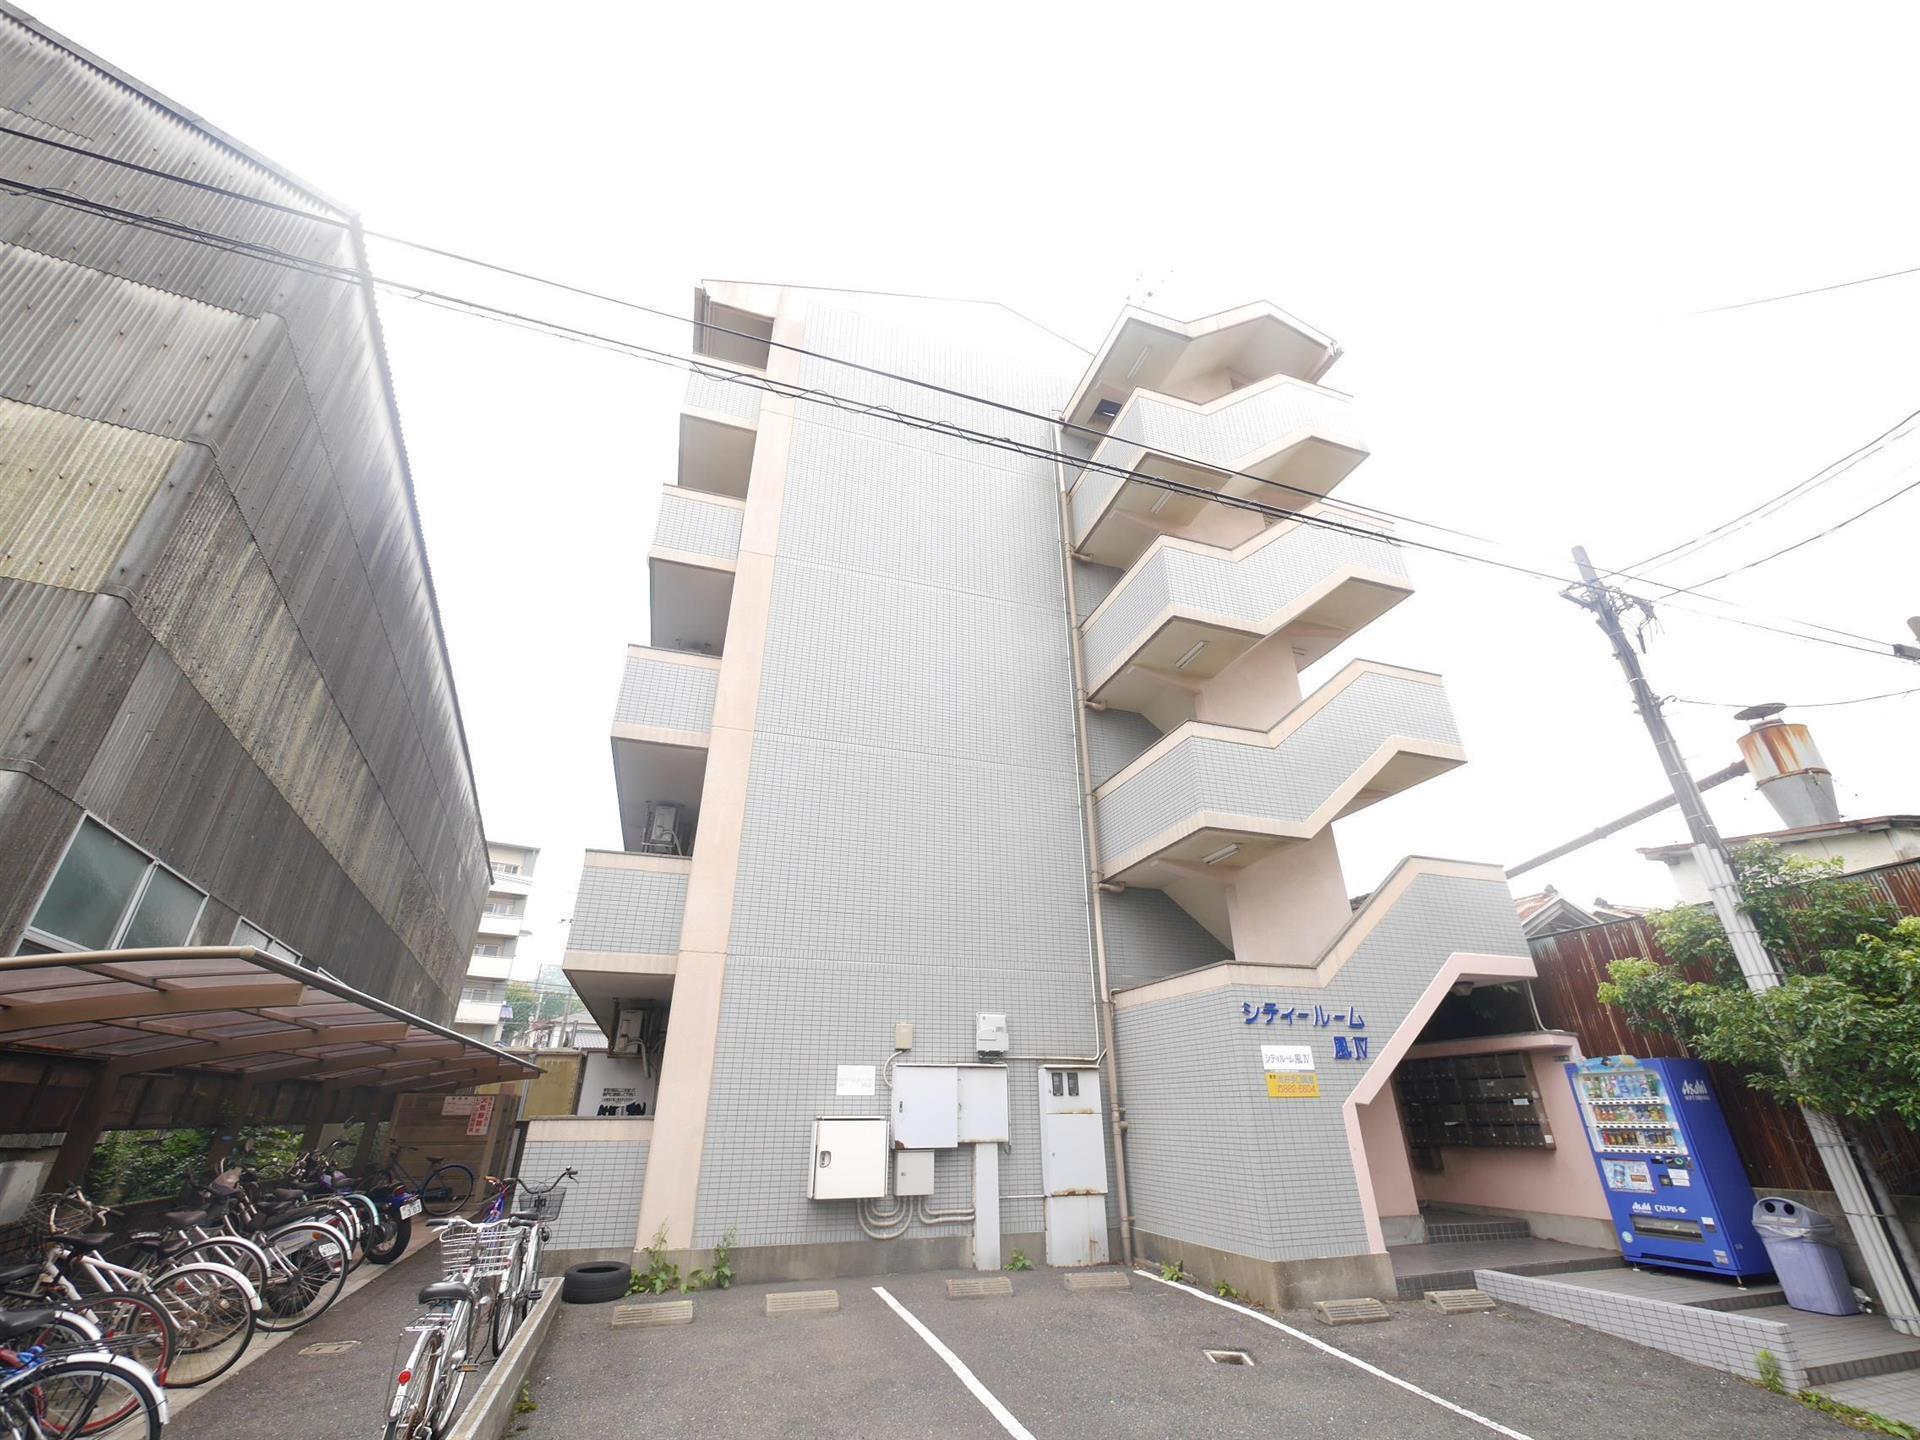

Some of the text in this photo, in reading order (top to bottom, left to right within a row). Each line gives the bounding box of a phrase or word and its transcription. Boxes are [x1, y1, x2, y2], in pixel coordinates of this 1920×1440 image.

[1242, 1002, 1365, 1029] シティールーム
[1682, 1079, 1708, 1095] Asahi
